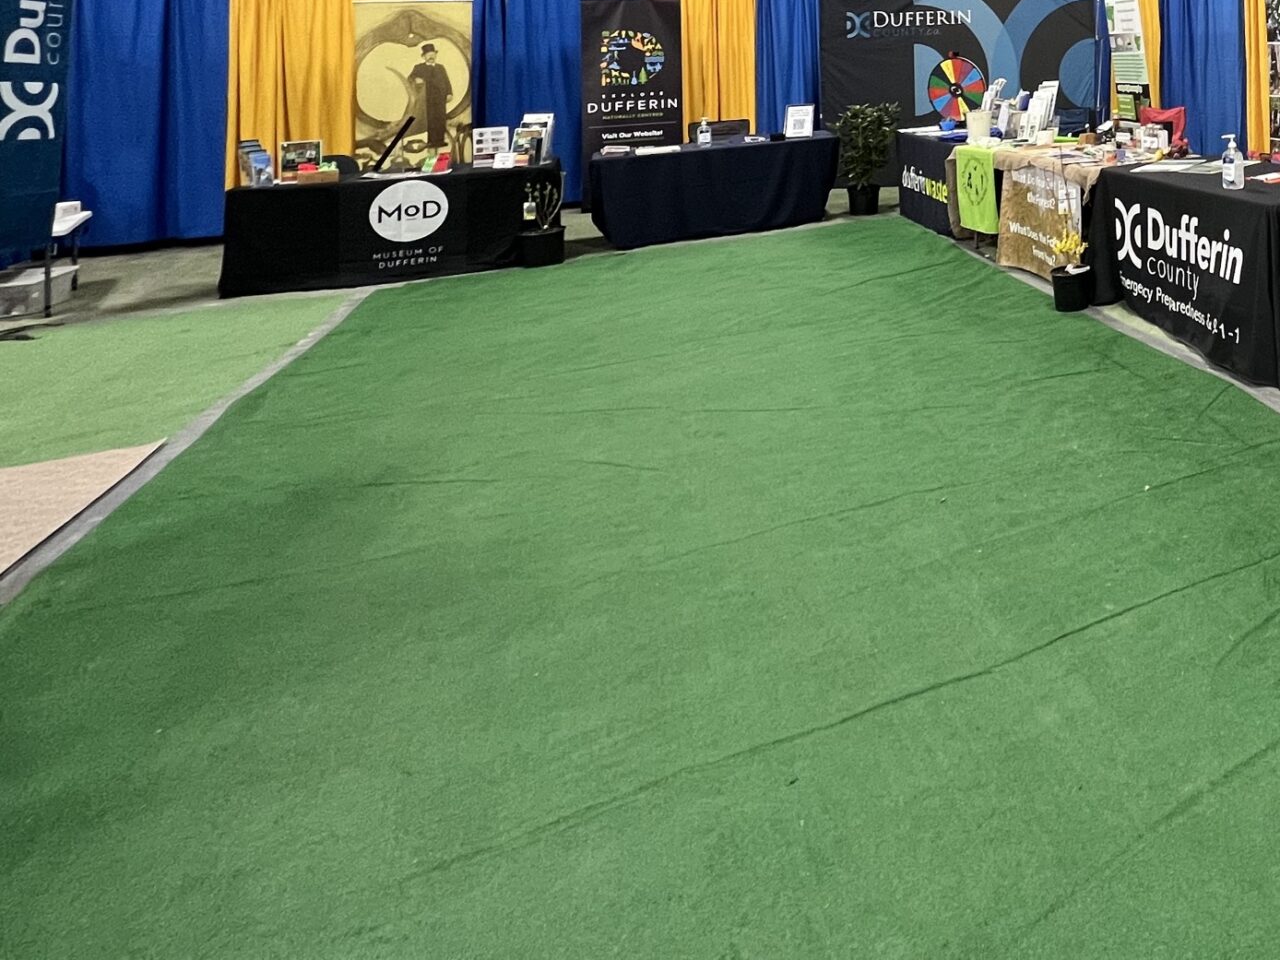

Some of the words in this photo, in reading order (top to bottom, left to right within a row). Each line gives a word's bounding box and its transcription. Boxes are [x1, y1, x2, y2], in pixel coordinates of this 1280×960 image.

[873, 9, 972, 28] DUFFERIN
[586, 98, 678, 114] DUFFERIN
[372, 248, 423, 260] MUSEUM
[428, 245, 444, 254] OF
[1147, 206, 1244, 285] Dufferin
[378, 255, 438, 270] DUFFERIN
[1146, 256, 1200, 301] county
